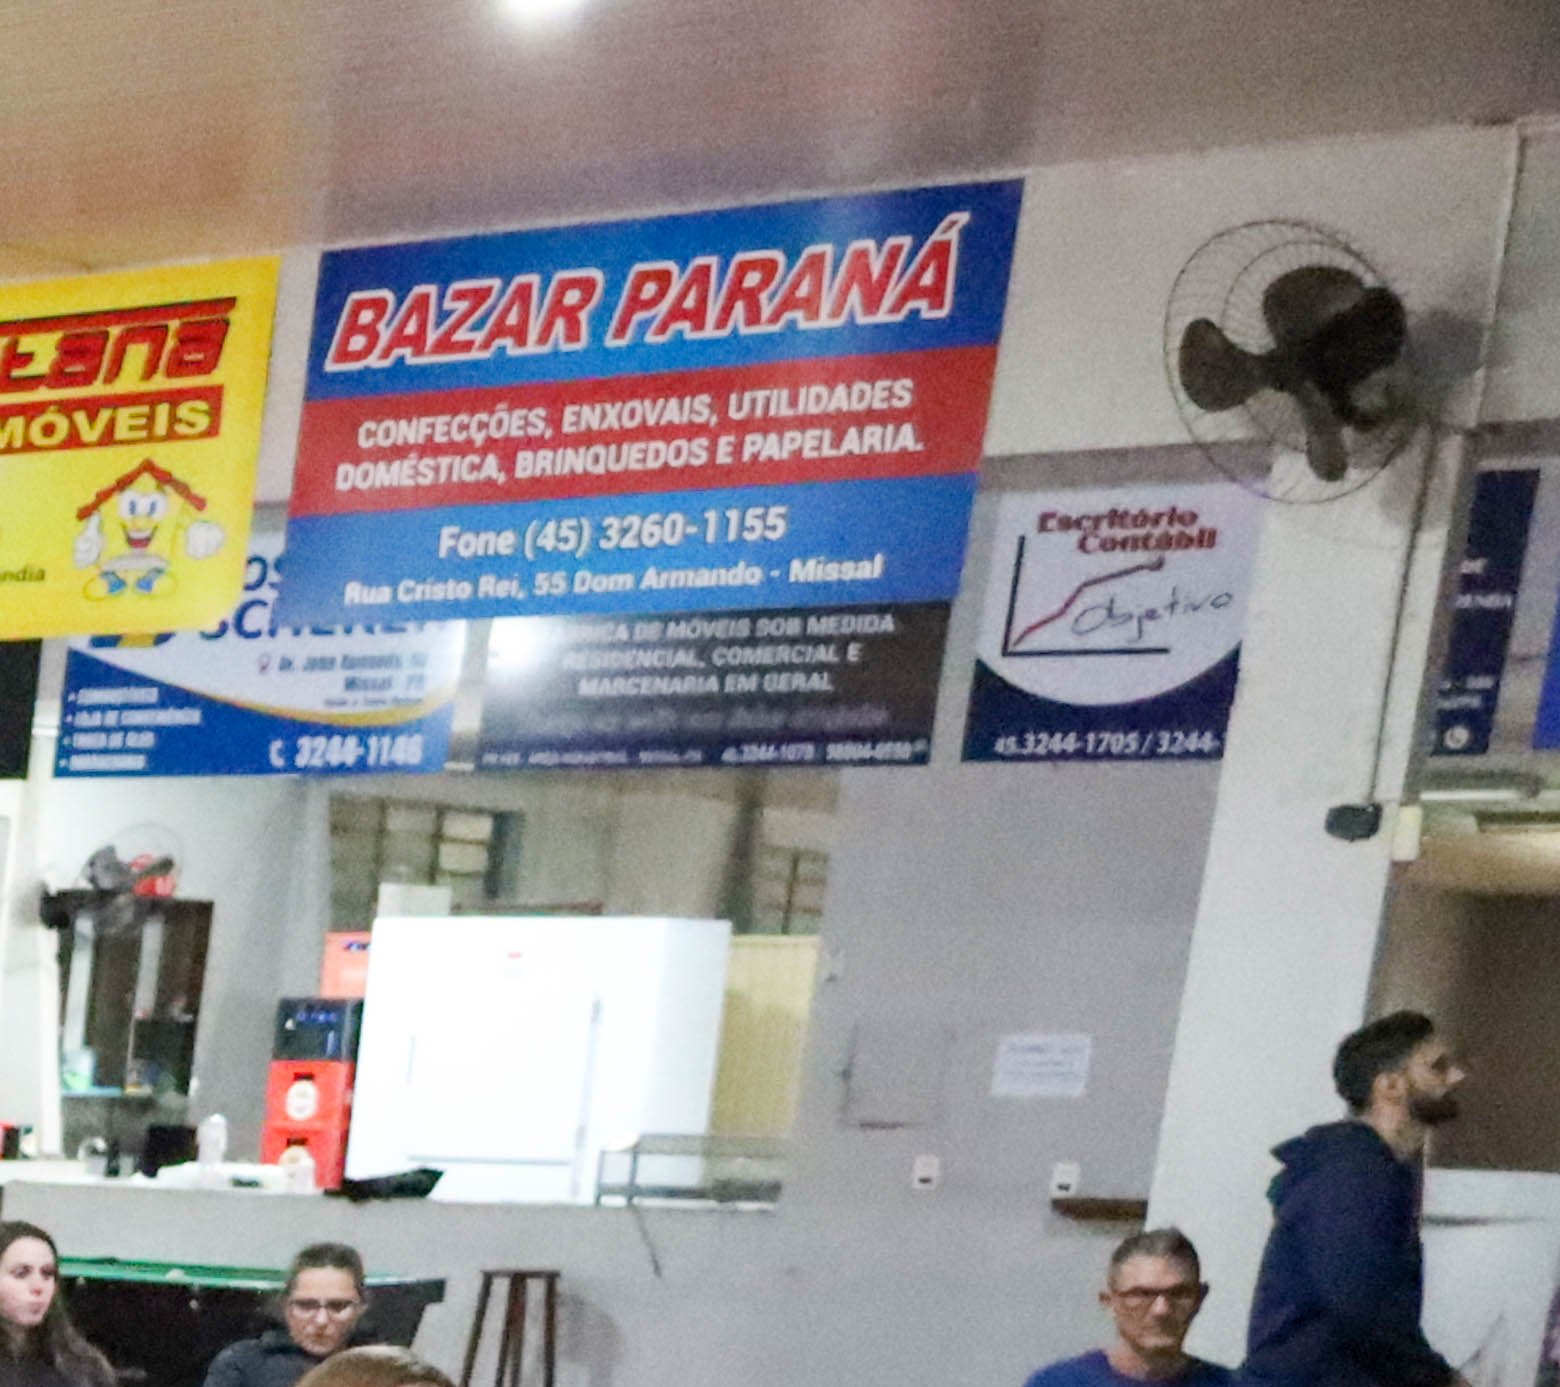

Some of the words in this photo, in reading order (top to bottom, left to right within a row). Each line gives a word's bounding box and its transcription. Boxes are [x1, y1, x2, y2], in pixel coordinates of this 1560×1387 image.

[324, 269, 604, 373] BAZAR
[606, 211, 972, 347] PARANÁ
[357, 406, 553, 451] CONFECÇÕES,
[561, 394, 719, 434] ENXOVAIS,
[728, 378, 913, 421] UTILIDADES
[335, 451, 507, 494] DOMÉSTICA,
[517, 440, 708, 479] BRINQUEDOS
[715, 437, 734, 465] E
[740, 423, 924, 462] PAPELARIA.
[438, 524, 517, 562] Fone
[525, 518, 593, 562] (45)
[599, 506, 788, 548] 3260-1155
[1037, 506, 1200, 533] Escritório
[1077, 527, 1218, 553] Contábil
[343, 580, 395, 606] Rua
[396, 576, 471, 602] Cristo
[477, 573, 523, 601] Rei,
[533, 571, 567, 596] 55
[573, 570, 635, 594] Dom
[639, 563, 763, 591] Armando
[788, 553, 884, 583] Missal
[806, 613, 896, 636] MEDIDA
[1070, 586, 1234, 644] Objetivo
[712, 643, 840, 667] COMERCIAL
[846, 641, 864, 662] E
